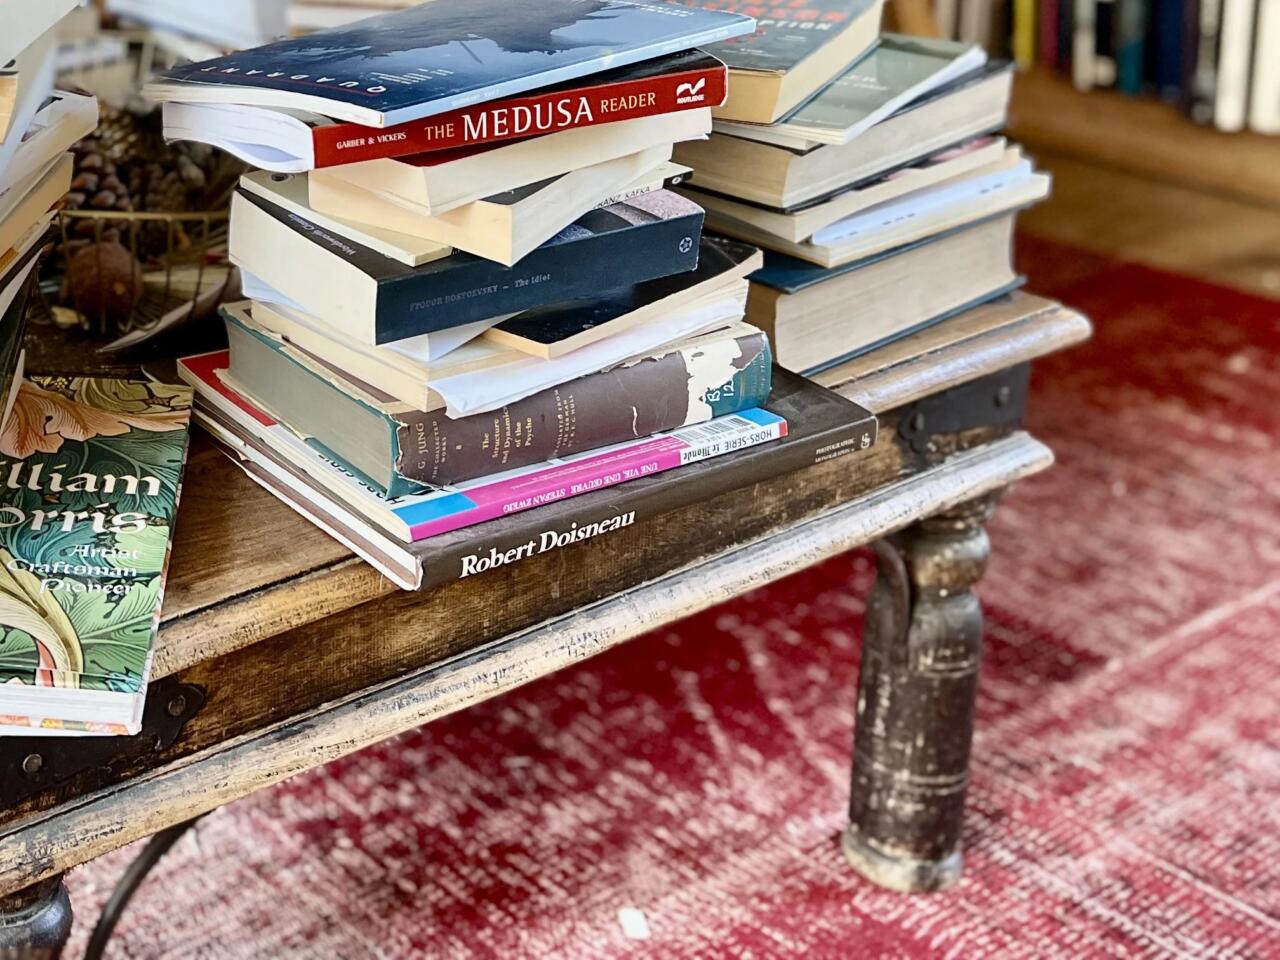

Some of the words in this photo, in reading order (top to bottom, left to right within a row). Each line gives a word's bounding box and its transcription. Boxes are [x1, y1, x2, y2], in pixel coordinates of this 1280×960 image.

[200, 65, 387, 94] QUADRANT
[676, 93, 705, 105] ROUTLEDGE
[424, 122, 455, 141] THE
[462, 96, 595, 141] MEDUSA
[600, 92, 657, 114] READER
[336, 139, 366, 150] GARBER
[368, 137, 375, 145] &
[376, 132, 407, 145] VICKERS
[595, 195, 620, 208] RANZ
[624, 186, 651, 200] KAFKA
[410, 296, 443, 312] FYODOR
[444, 284, 499, 304] DOSTOEVSKY
[514, 278, 529, 288] The
[531, 273, 551, 284] Idiot
[416, 422, 429, 454] JUNG
[481, 432, 490, 449] The
[492, 418, 501, 458] Structure
[524, 417, 535, 447] Psyche
[440, 436, 448, 463] WORKS
[683, 446, 711, 460] Monde
[603, 471, 621, 485] UNE
[640, 462, 659, 476] UNE
[503, 496, 532, 514] ZWEIG
[531, 487, 566, 505] STEFAN
[69, 544, 139, 559] Artist
[459, 540, 536, 579] Robert
[537, 510, 636, 554] Doisneau
[7, 558, 137, 578] Craftsman
[40, 578, 133, 595] Pioneer
